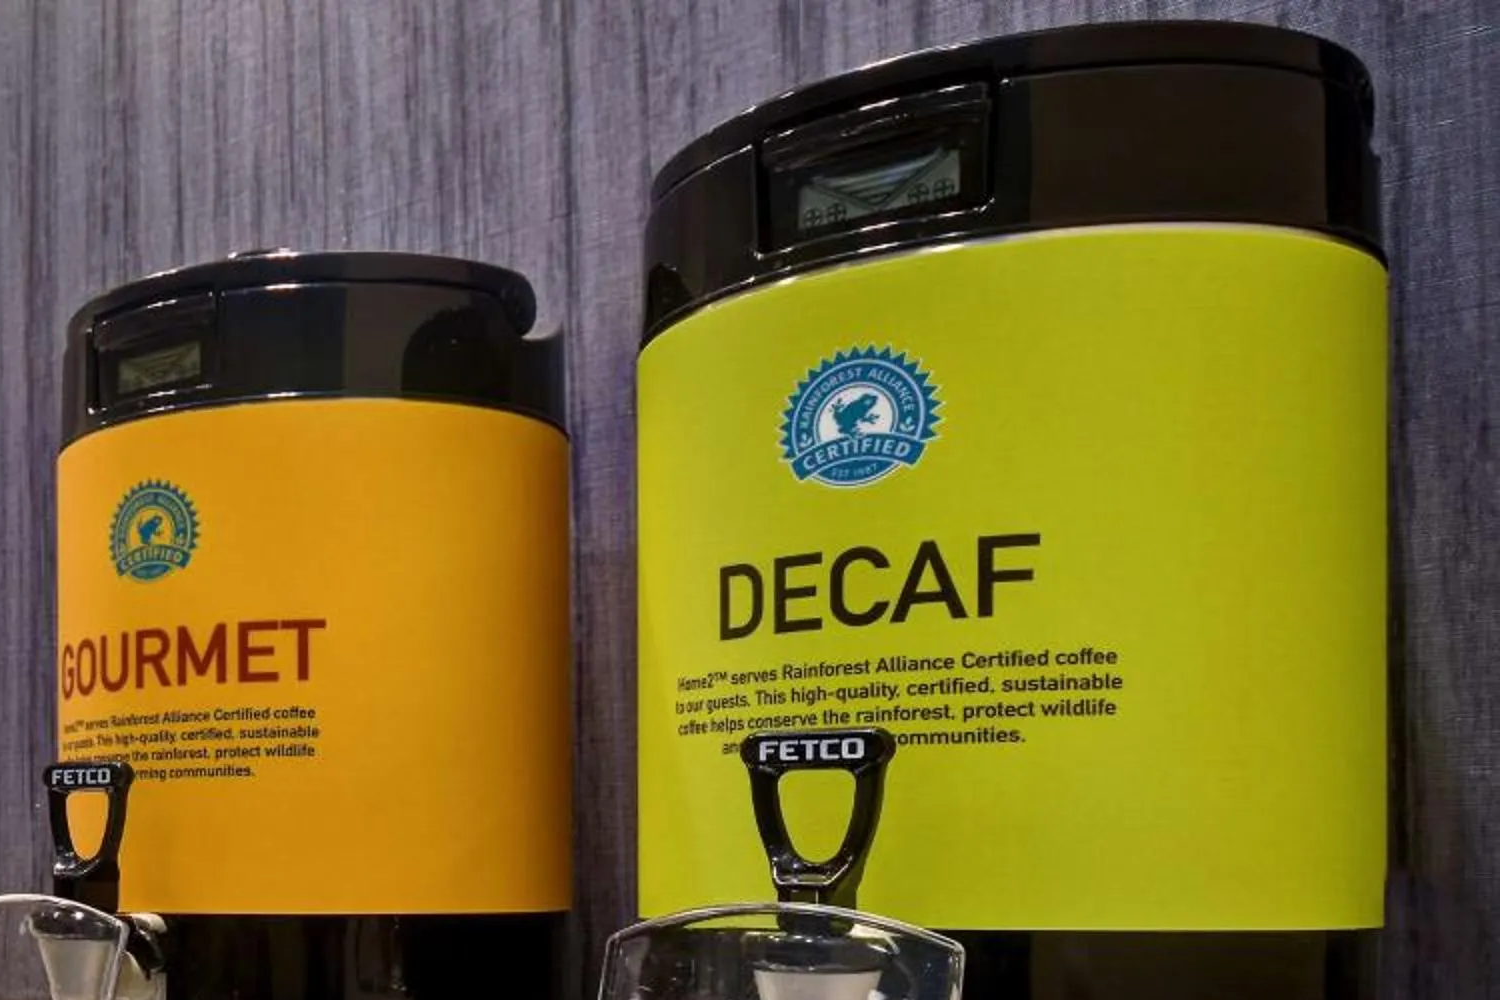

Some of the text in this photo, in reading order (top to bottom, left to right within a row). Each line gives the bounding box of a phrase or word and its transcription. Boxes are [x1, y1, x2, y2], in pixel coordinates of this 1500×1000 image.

[800, 367, 915, 428] RAINFOREST ALLIANCE
[803, 437, 911, 470] CERTIFIED
[719, 532, 1041, 641] DECAF
[62, 618, 326, 700] GOURMET
[730, 668, 777, 685] serves
[782, 659, 870, 680] Rainforest
[875, 655, 955, 673] Alliance
[961, 649, 1049, 669] Certified
[1055, 647, 1118, 665] coffee
[686, 701, 703, 713] our
[755, 689, 786, 706] This
[1001, 673, 1123, 693] sustainable
[163, 710, 210, 722] Alliance
[213, 707, 271, 721] Certified
[273, 705, 316, 719] coffee
[678, 719, 708, 736] coffee
[710, 716, 744, 734] helps
[747, 712, 818, 730] conserve
[823, 708, 849, 724] the
[963, 701, 1035, 723] protect
[1041, 698, 1117, 717] wildlife
[240, 725, 320, 739] sustainable
[723, 727, 1026, 755] an ommunities.
[215, 746, 261, 761] protect
[264, 743, 316, 757] wildlife
[759, 737, 865, 762] FETCO
[51, 767, 111, 785] FETCO
